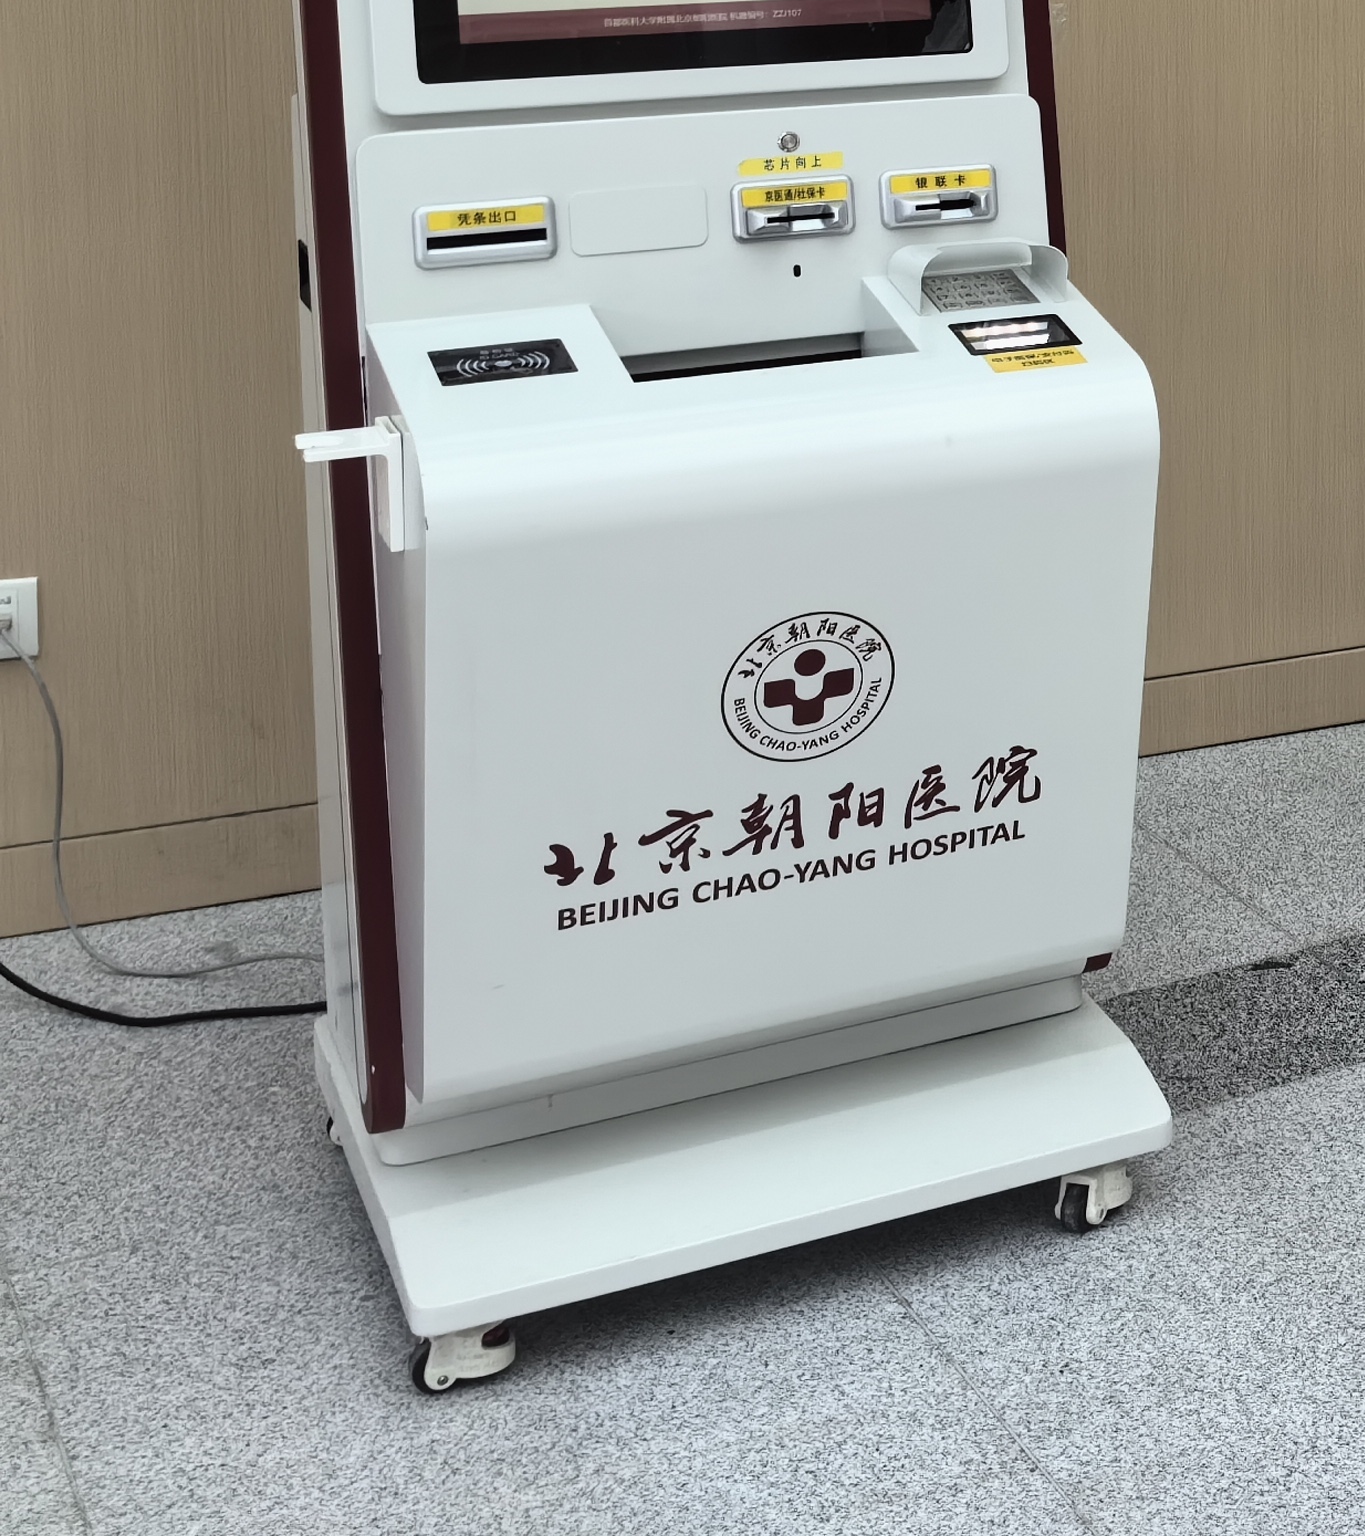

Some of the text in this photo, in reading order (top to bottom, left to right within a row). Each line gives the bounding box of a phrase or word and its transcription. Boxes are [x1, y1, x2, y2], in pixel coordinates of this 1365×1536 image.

[763, 155, 822, 171] 芯片向上
[915, 174, 967, 189] 银联卡
[764, 186, 826, 202] 京医通/社保卡
[457, 210, 516, 227] 凭条出口
[737, 617, 882, 679] 北京朝阳医院
[733, 677, 882, 752] BEIJING CHAO-YANG HOSPITAL
[544, 745, 1042, 886] 北京朝阳医院
[557, 819, 1026, 931] BEIJING CHAO-YANG HOSPITAL
